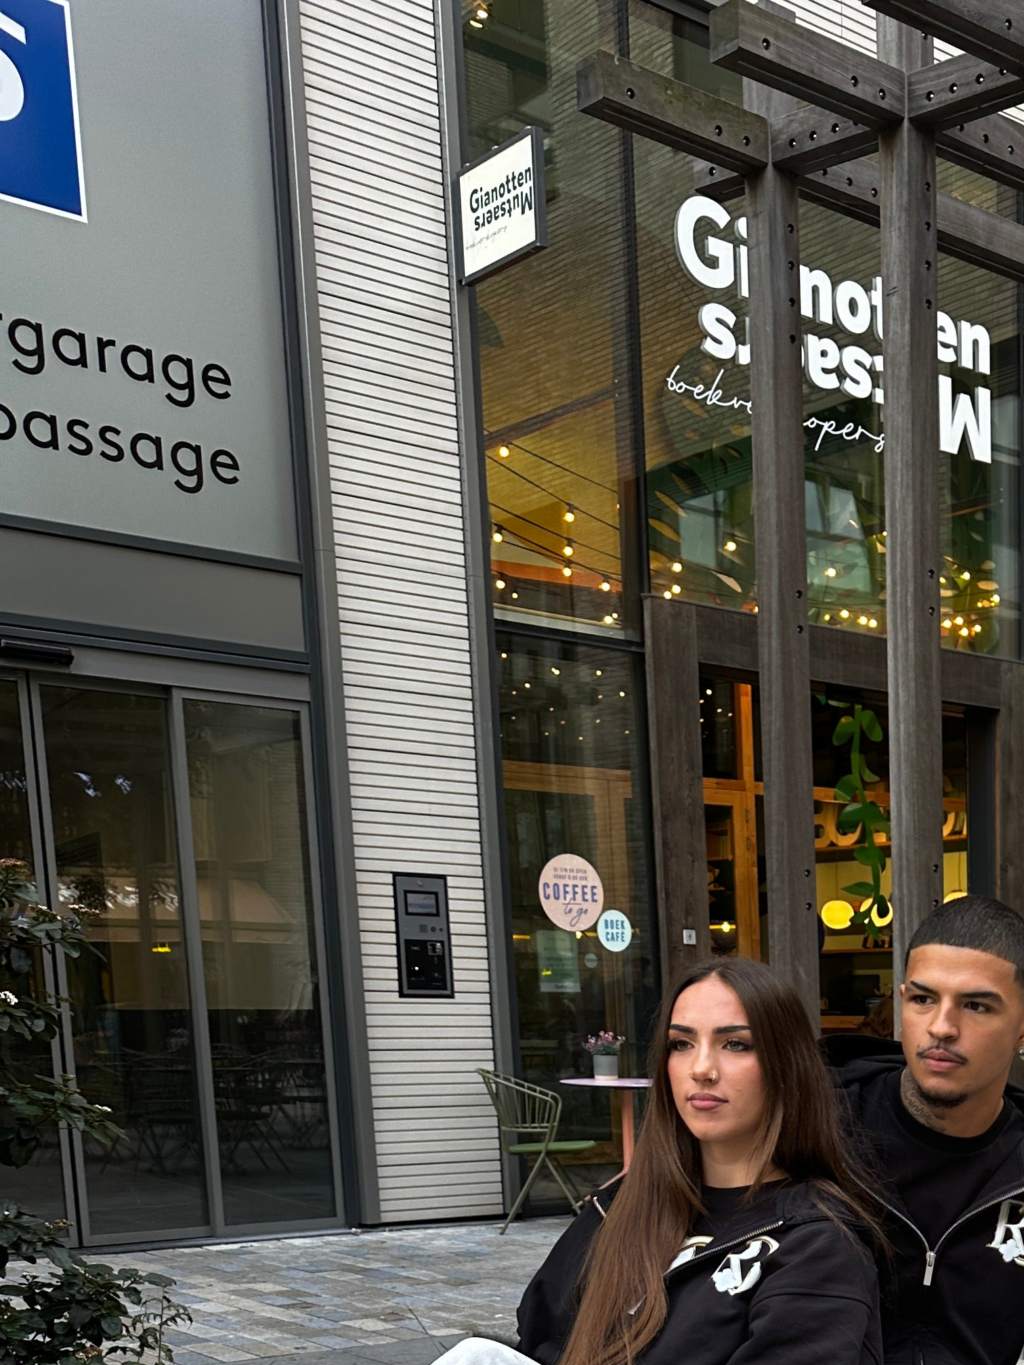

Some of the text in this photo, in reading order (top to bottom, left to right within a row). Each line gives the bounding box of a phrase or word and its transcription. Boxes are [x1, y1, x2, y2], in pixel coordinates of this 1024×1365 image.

[469, 166, 532, 214] Gianotten
[474, 186, 533, 232] Mutsaers
[674, 195, 991, 376] Ginoten
[0, 313, 232, 408] garage
[543, 882, 598, 903] COFFEE
[563, 898, 582, 915] to
[569, 907, 589, 928] go
[604, 919, 626, 930] BOEK
